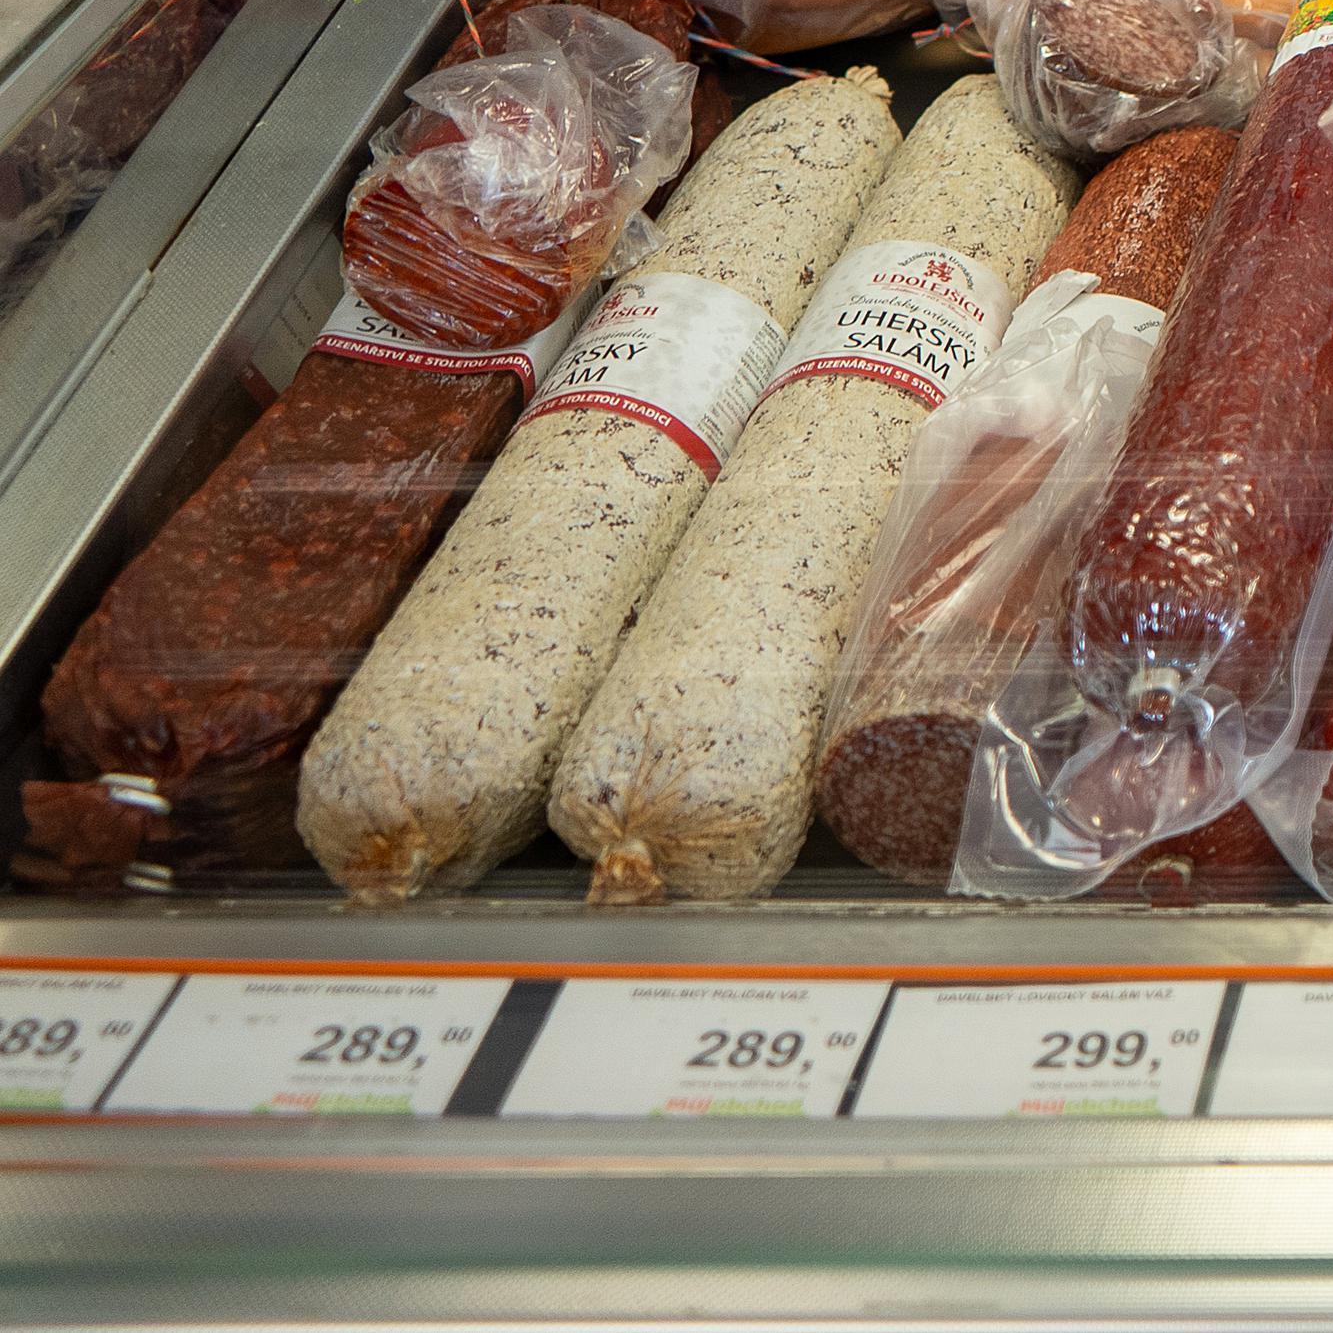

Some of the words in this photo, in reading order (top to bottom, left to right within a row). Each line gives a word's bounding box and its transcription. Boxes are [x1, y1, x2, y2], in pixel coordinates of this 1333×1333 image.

[872, 272, 888, 284] U
[889, 273, 986, 323] DOLEJŠÍCH
[325, 337, 405, 362] UZENÁŘSTVÍ
[406, 352, 424, 364] SE
[424, 355, 489, 369] STOLETOU
[490, 354, 535, 379] TRADICÍ
[836, 310, 976, 370] UHERSKÝ
[843, 331, 951, 381] SALÁM
[816, 359, 893, 378] UZENÁŘSTVÍ
[894, 368, 910, 382] SE
[559, 393, 620, 408] STOLETOU
[621, 397, 674, 428] TRADICÍ
